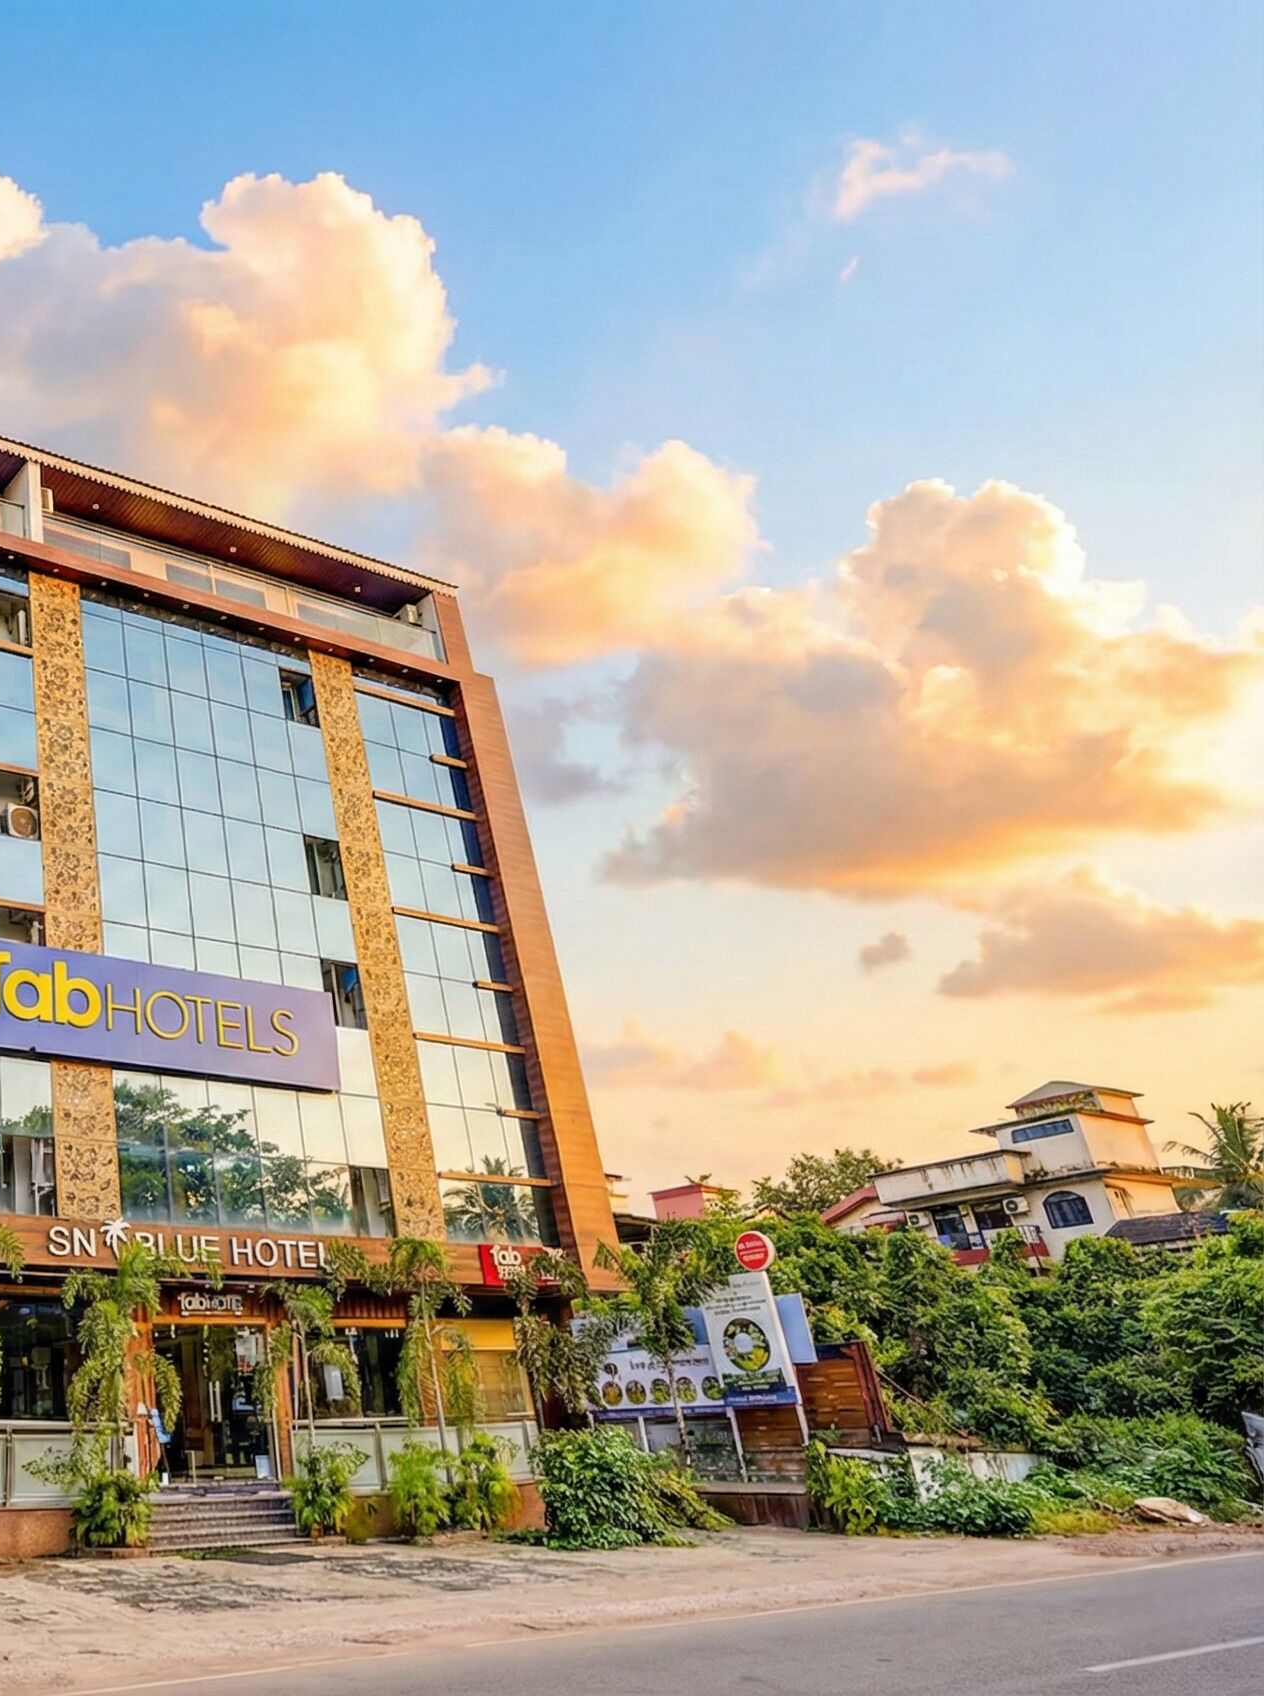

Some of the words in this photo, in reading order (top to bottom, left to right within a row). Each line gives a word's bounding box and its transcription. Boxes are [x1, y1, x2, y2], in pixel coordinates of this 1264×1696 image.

[48, 1226, 97, 1257] SN
[134, 1231, 221, 1264] BLUE
[230, 1235, 329, 1270] HOTEL
